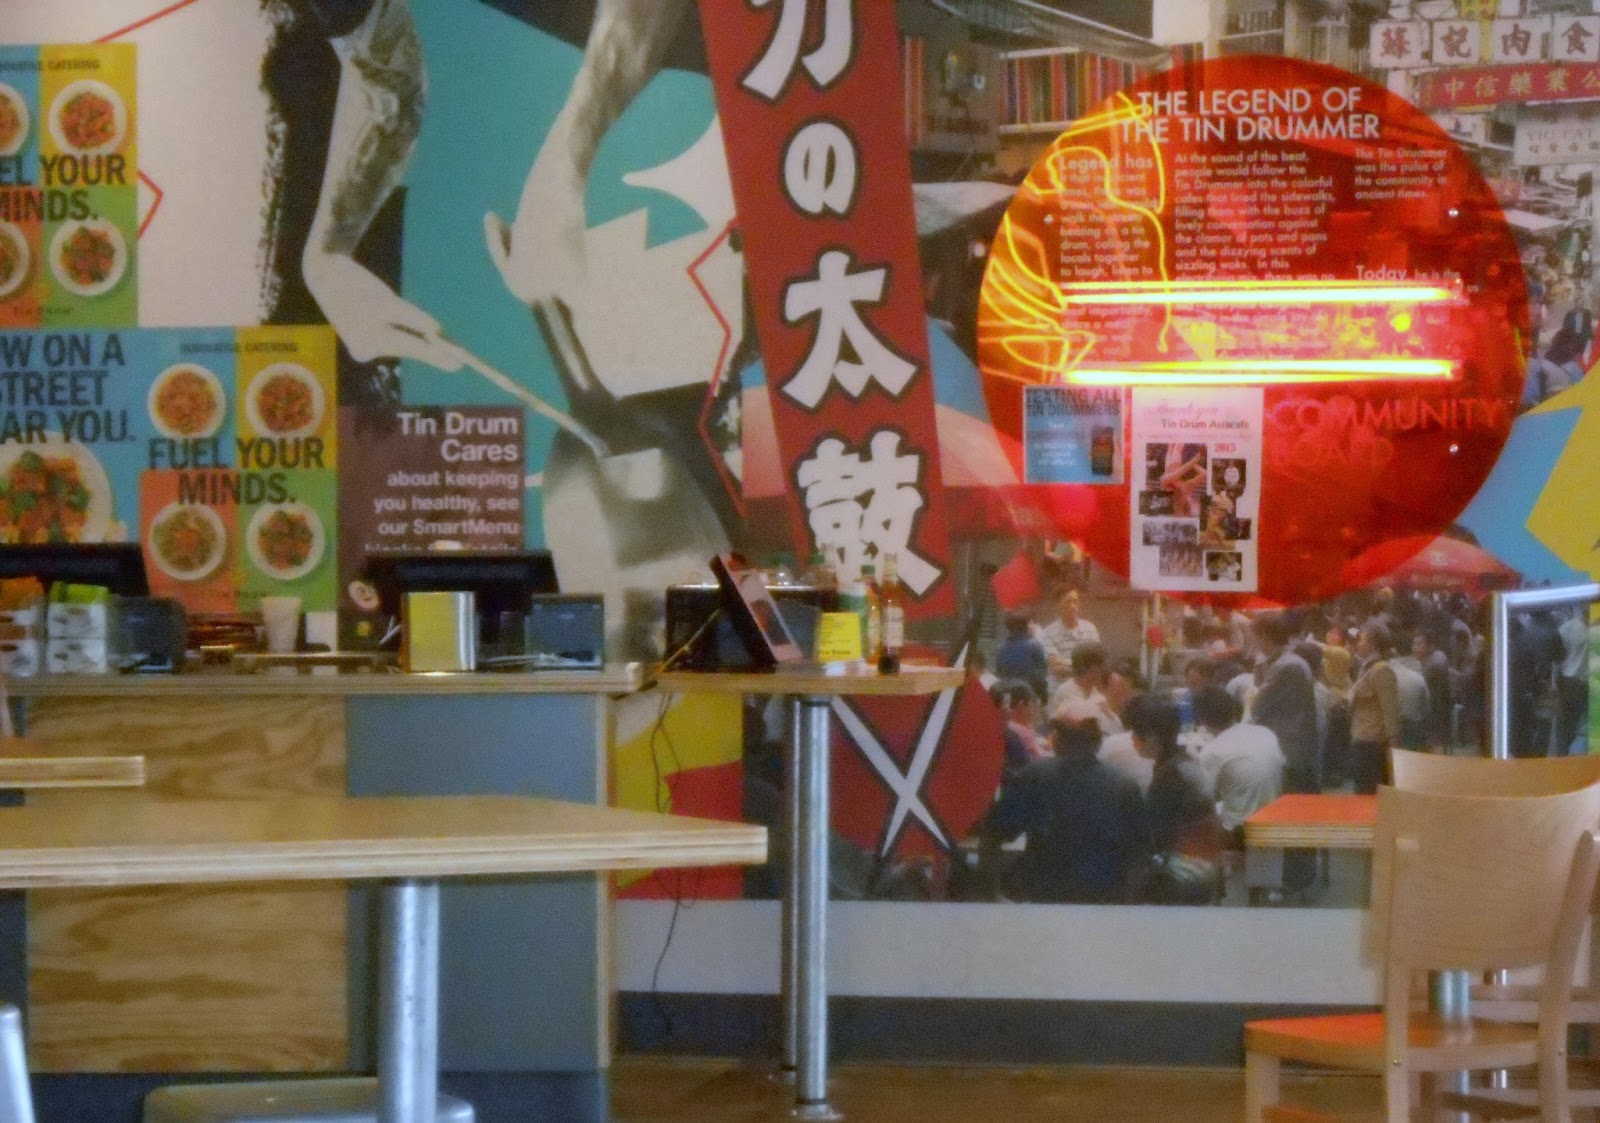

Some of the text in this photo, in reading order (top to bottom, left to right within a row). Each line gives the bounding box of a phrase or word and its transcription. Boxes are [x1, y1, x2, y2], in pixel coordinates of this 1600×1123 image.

[1137, 86, 1362, 117] THE LEGEND OF
[1121, 113, 1381, 144] THE TIN DRUMMER
[1124, 152, 1153, 169] has
[1190, 151, 1207, 163] the
[1211, 150, 1243, 163] sound
[1246, 149, 1258, 162] of
[1260, 149, 1278, 162] the
[1396, 146, 1448, 159] Drummer
[40, 153, 126, 187] YOUR
[1175, 163, 1307, 180] people would follow the
[1355, 160, 1445, 175] was the pulse of
[1194, 178, 1244, 190] Drummer
[1270, 177, 1288, 188] the
[1291, 176, 1333, 188] colorful
[1355, 175, 1372, 187] the
[1375, 175, 1434, 189] community
[1260, 190, 1277, 202] the
[1237, 204, 1261, 216] with
[1263, 203, 1280, 215] the
[1207, 218, 1276, 231] conversation
[1278, 218, 1318, 232] against
[1175, 232, 1192, 244] the
[1277, 231, 1298, 242] and
[1175, 246, 1196, 257] and
[1200, 245, 1217, 257] the
[1220, 244, 1267, 259] dizzying
[1305, 243, 1317, 255] of
[1356, 263, 1408, 281] Today
[43, 334, 91, 367] ON
[102, 333, 125, 366] A
[0, 371, 108, 406] TREET
[1271, 395, 1503, 431] COMMUNITY
[0, 409, 137, 444] AR YOU.
[396, 412, 519, 435] Tin Drum
[1161, 419, 1177, 430] Tin
[1180, 419, 1206, 430] Drum
[148, 437, 325, 470] FUEL YOUR
[440, 438, 519, 463] Cares
[179, 472, 297, 505] MINDS.
[387, 470, 519, 490] about keeping
[374, 495, 519, 514] you healthy, see
[378, 518, 519, 536] our SmartMenu
